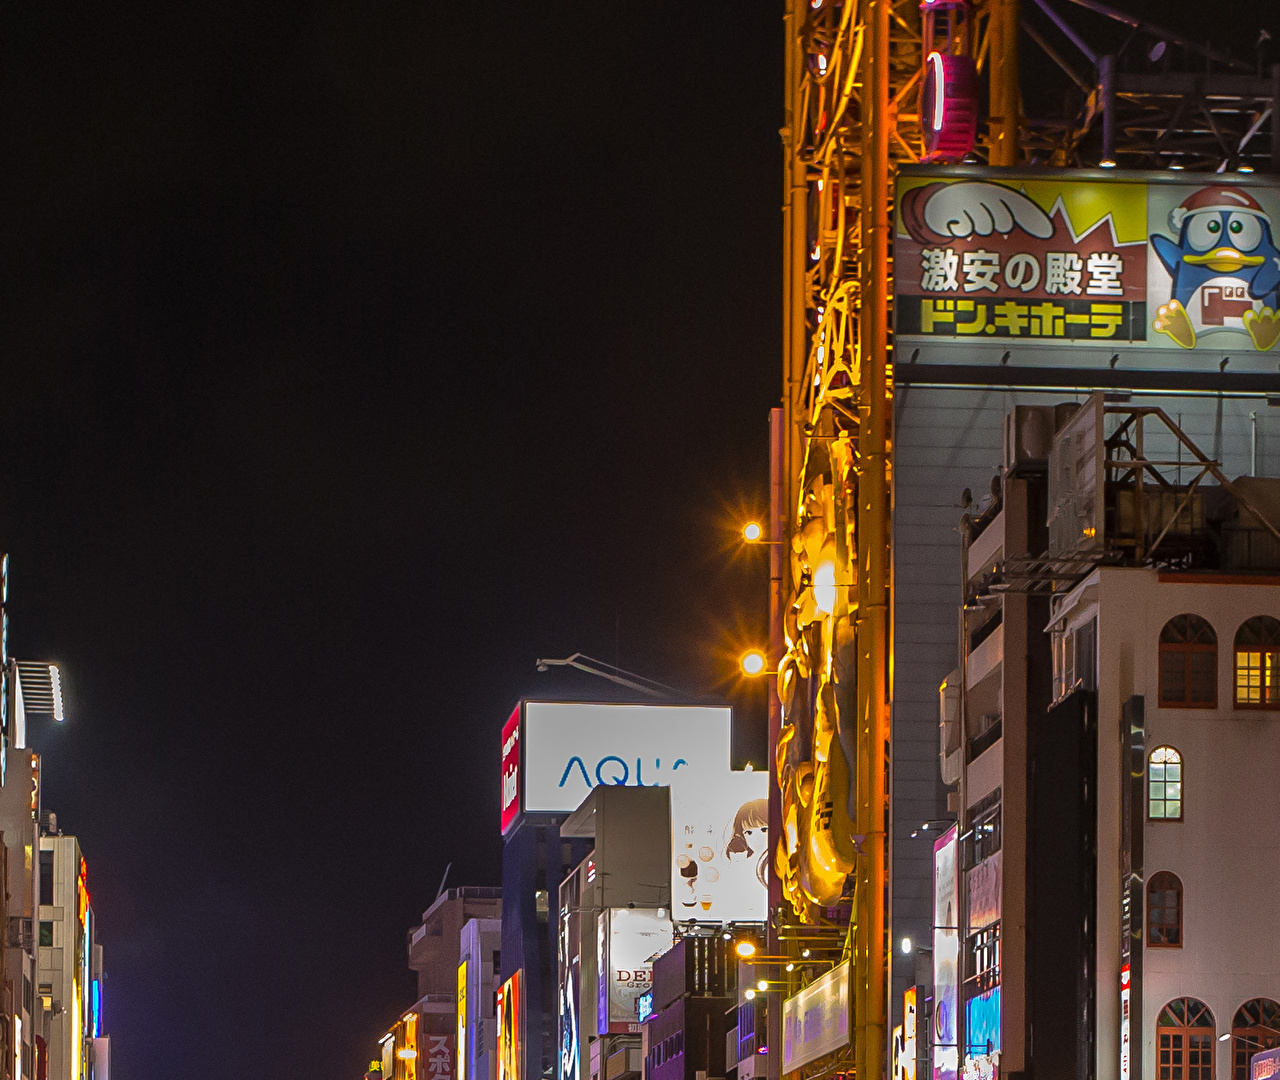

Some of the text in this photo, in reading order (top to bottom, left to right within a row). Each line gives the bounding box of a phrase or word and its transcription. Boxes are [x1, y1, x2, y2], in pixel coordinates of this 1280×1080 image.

[920, 248, 1124, 296] 激安の殿堂
